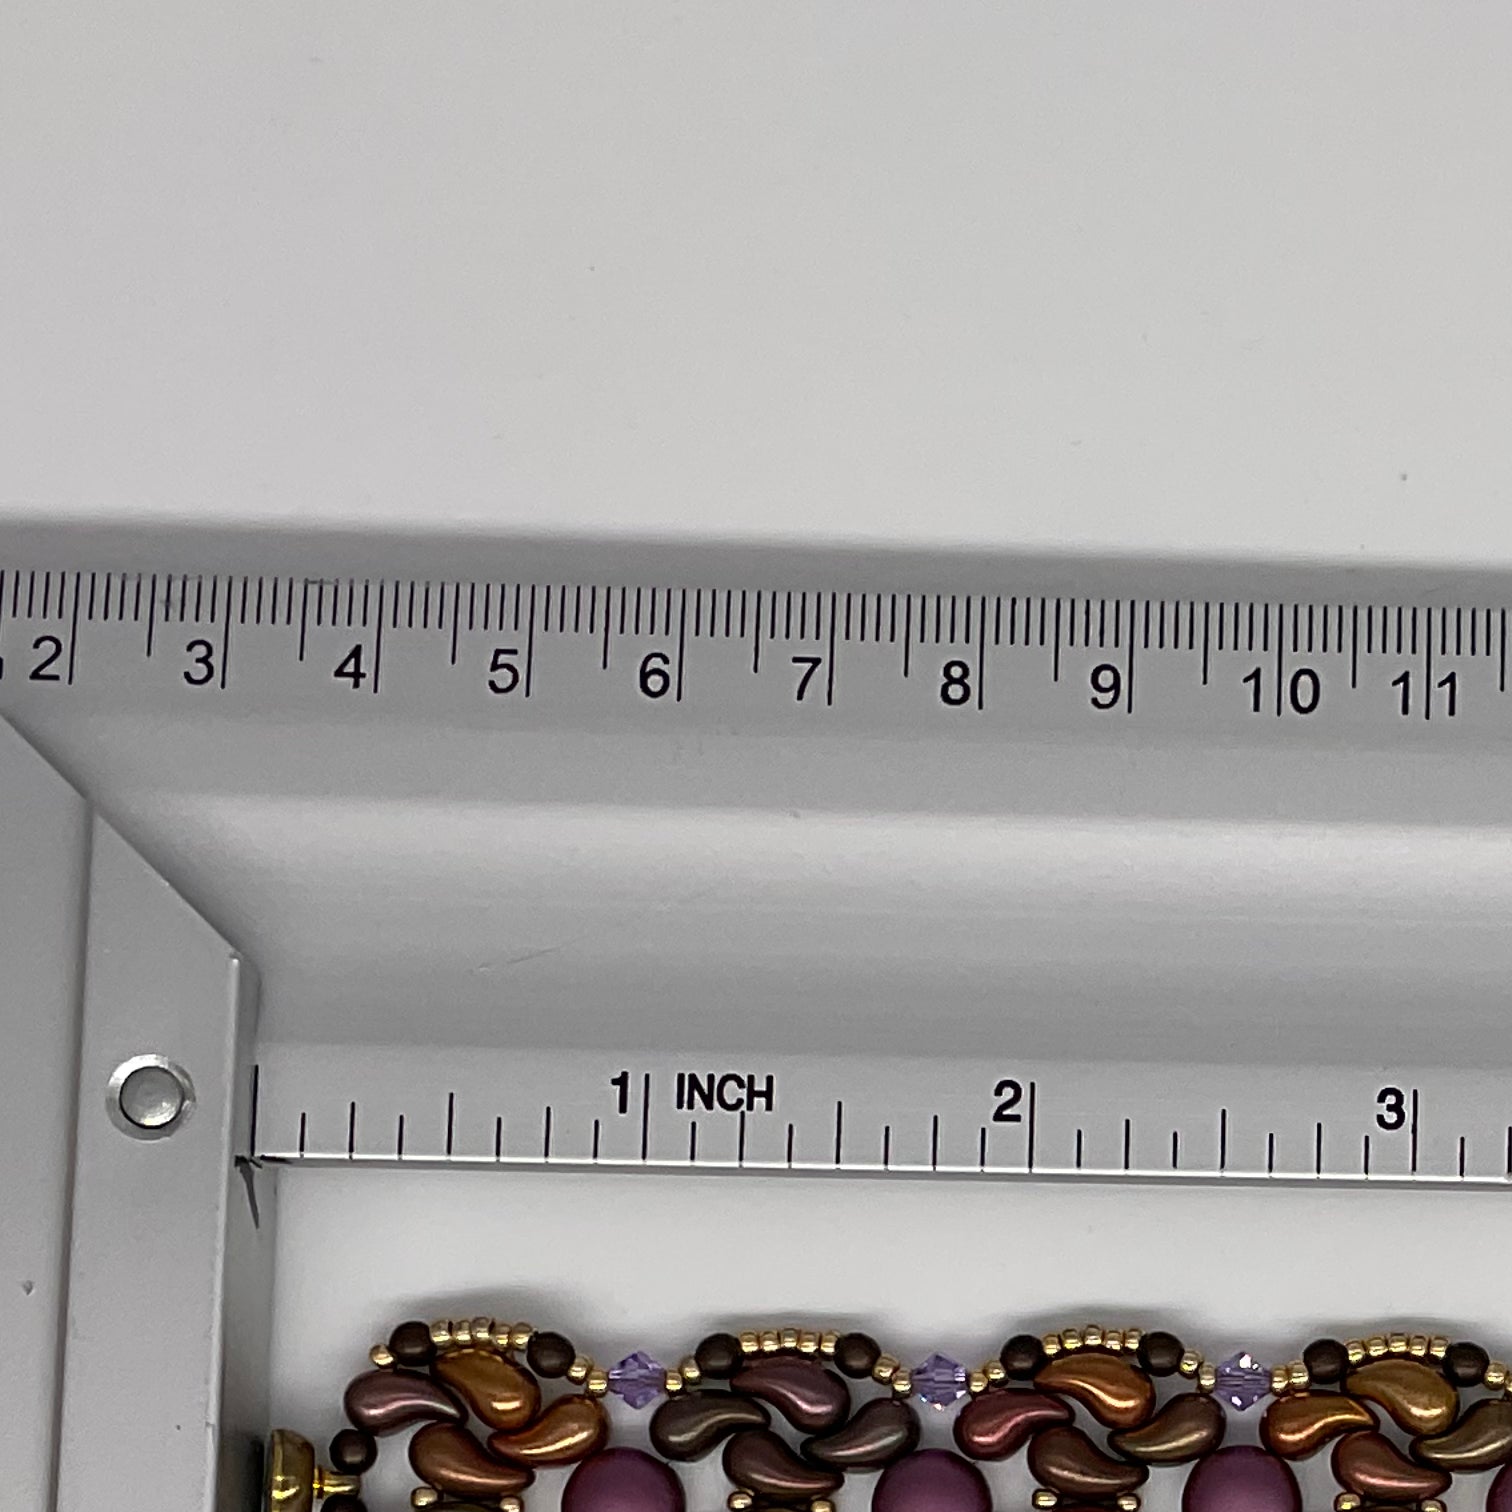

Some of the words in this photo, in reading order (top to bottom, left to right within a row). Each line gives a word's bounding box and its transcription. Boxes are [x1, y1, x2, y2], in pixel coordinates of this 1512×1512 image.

[28, 635, 63, 682] 2
[183, 639, 215, 686] 3
[333, 643, 367, 689] 4
[488, 648, 520, 694] 5
[639, 652, 670, 699] 6
[791, 656, 823, 701] 7
[940, 660, 971, 706] 8
[1090, 663, 1121, 710] 9
[1242, 666, 1321, 715] 10
[1391, 670, 1457, 717] 11
[611, 1071, 629, 1114] 1
[674, 1072, 774, 1112] INCH
[992, 1079, 1022, 1123] 2
[1376, 1087, 1406, 1131] 3
